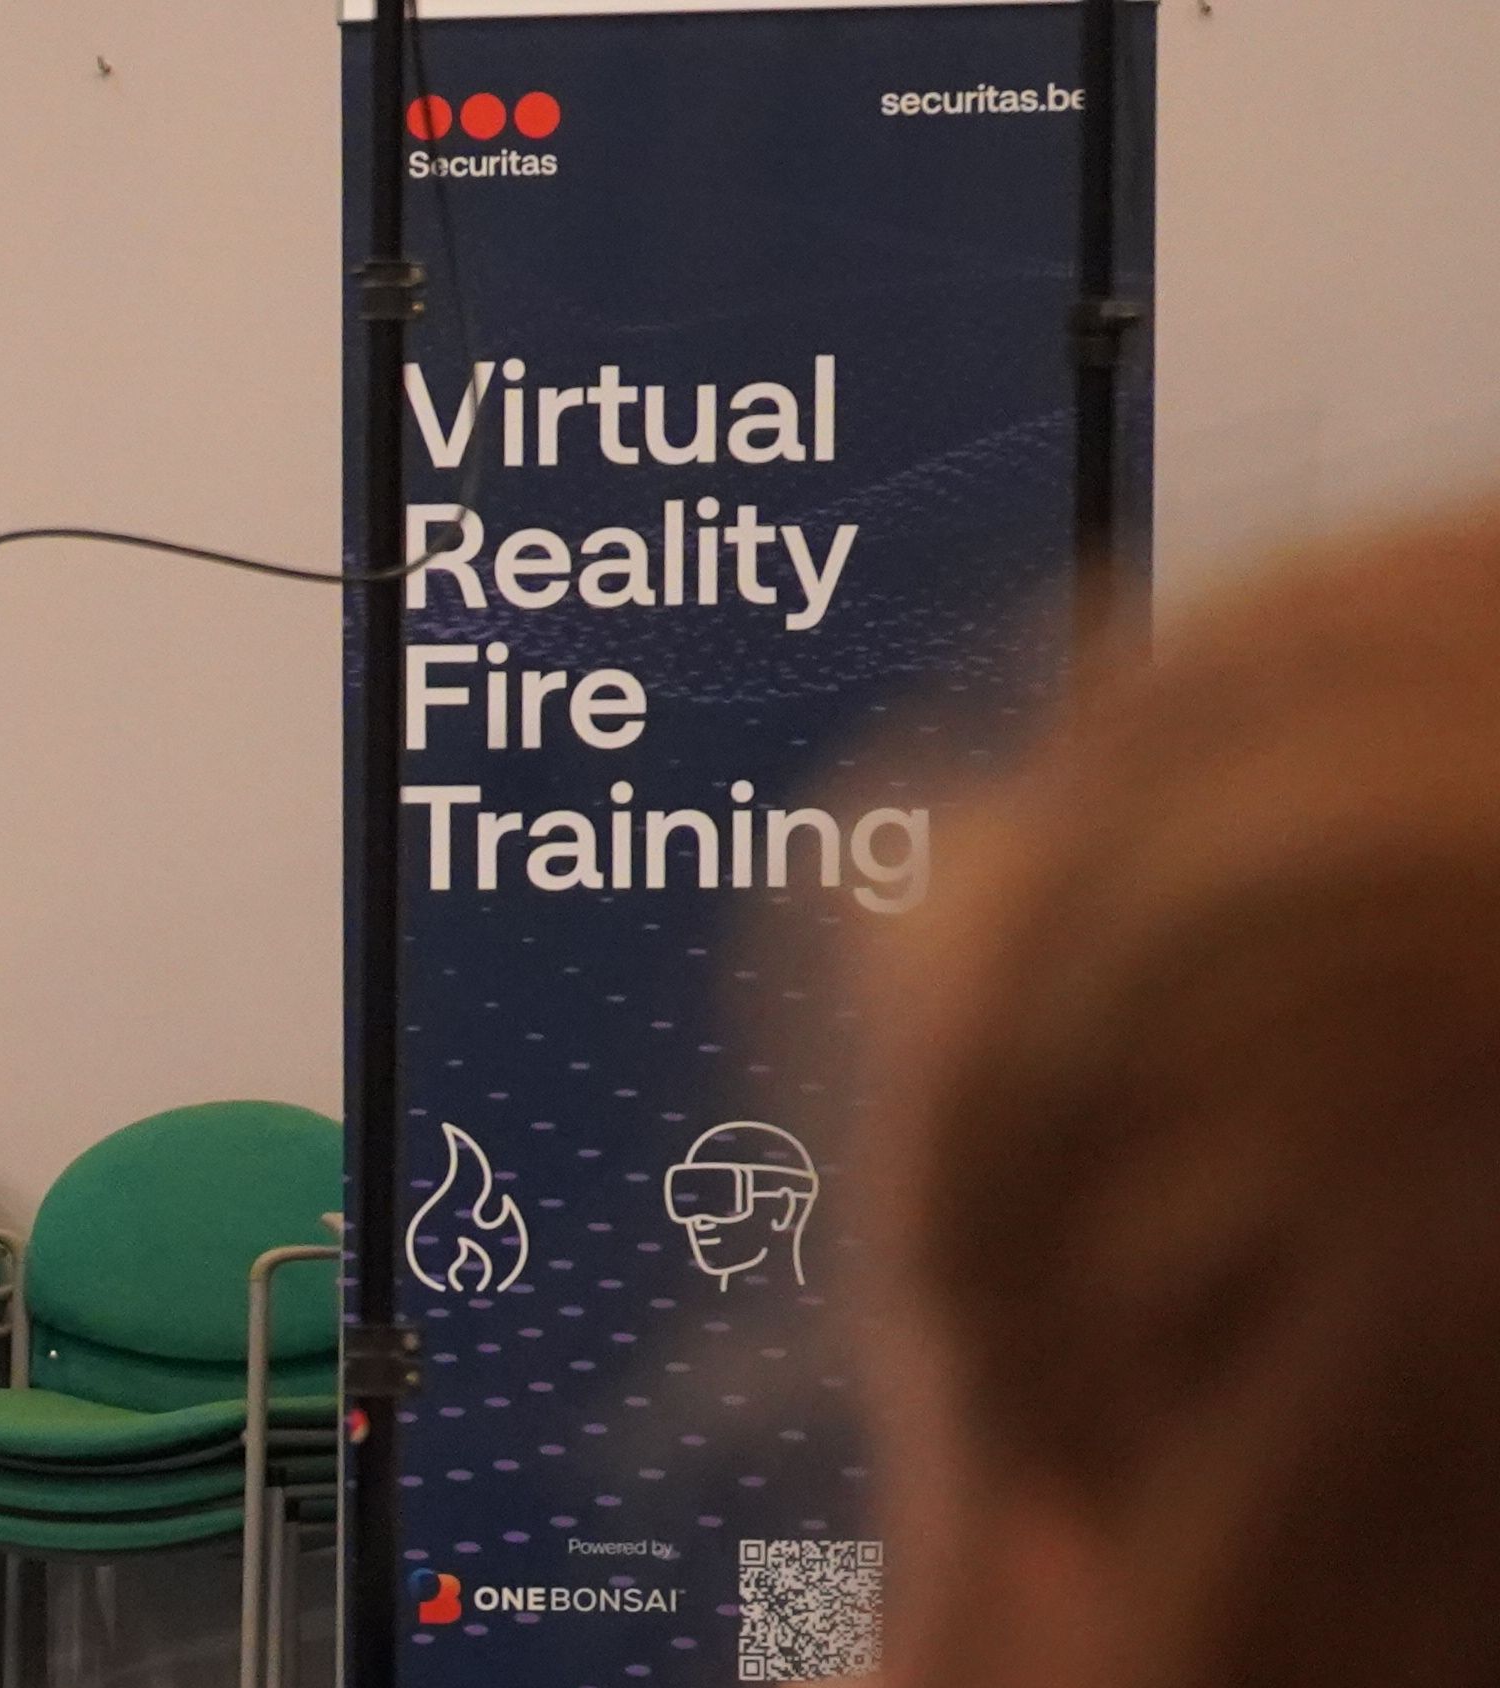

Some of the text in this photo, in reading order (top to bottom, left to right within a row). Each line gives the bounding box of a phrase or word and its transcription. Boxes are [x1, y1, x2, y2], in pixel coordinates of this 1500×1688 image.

[880, 82, 1086, 116] securitas.be
[408, 148, 559, 179] Securitas
[402, 353, 836, 468] Virtual
[404, 495, 859, 632] Reality
[404, 640, 648, 750] Fire
[400, 779, 930, 914] Training
[567, 1538, 674, 1559] Powered by
[472, 1585, 678, 1613] ONEBONSAI
